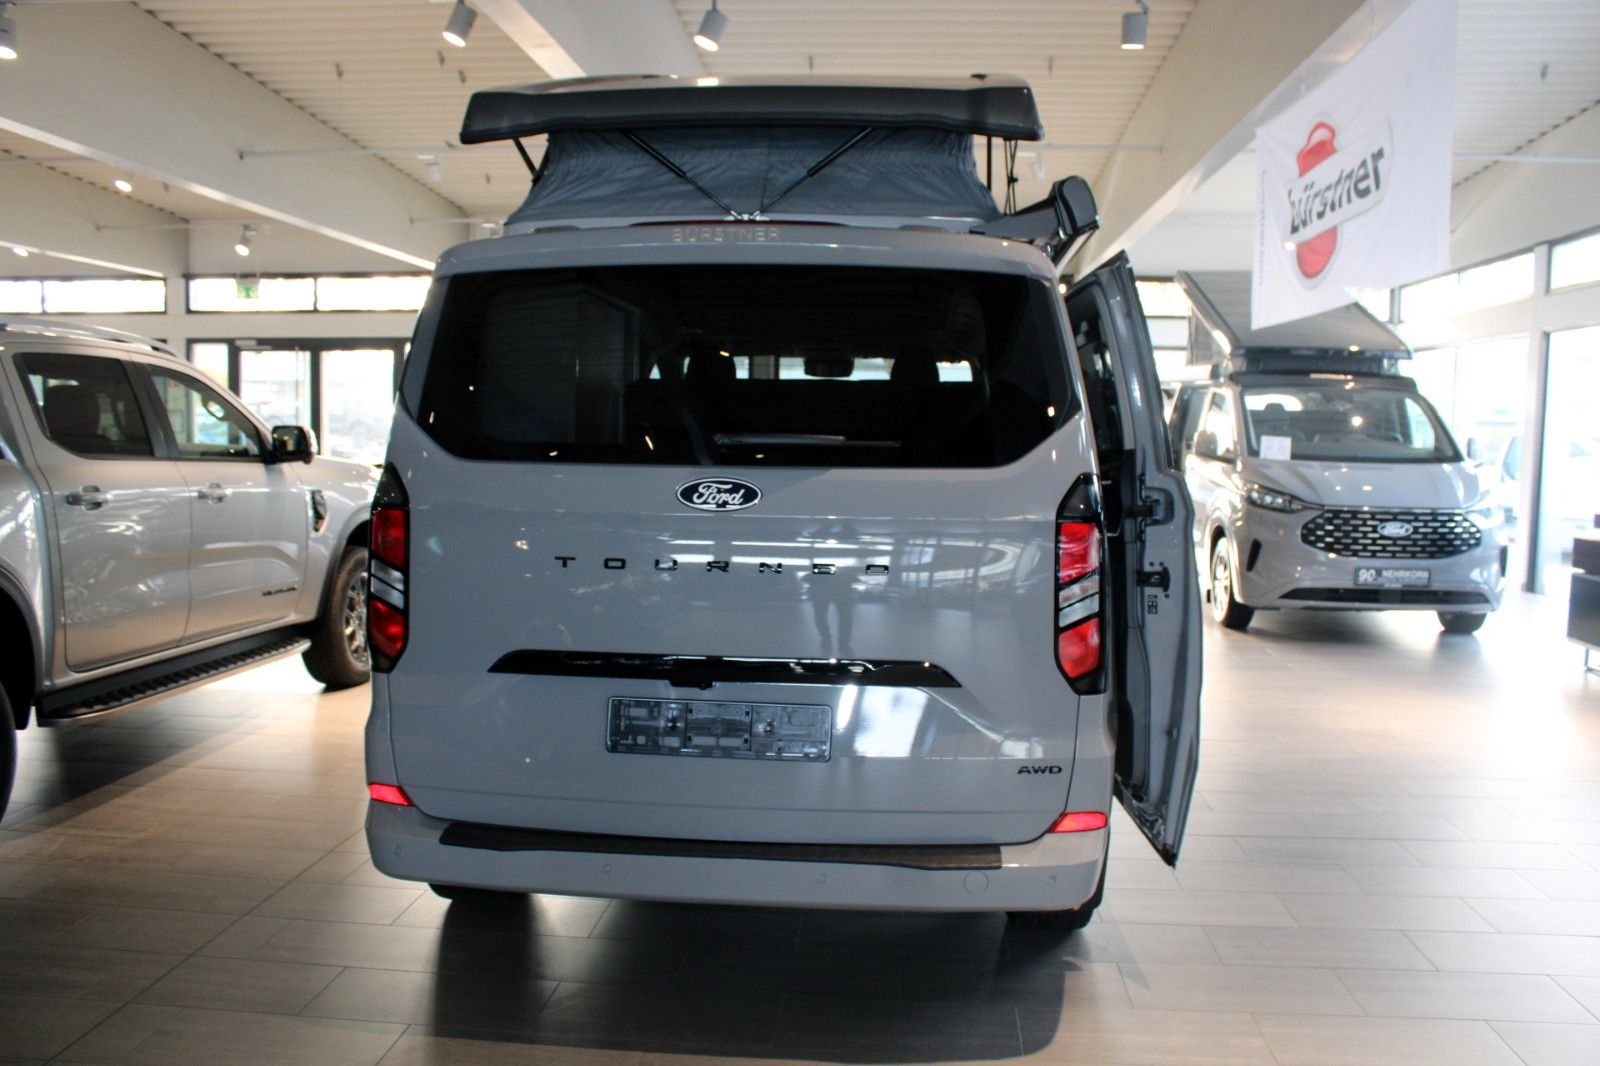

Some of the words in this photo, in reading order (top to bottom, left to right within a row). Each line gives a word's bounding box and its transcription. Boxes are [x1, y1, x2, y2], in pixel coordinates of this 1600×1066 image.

[1288, 146, 1385, 235] bürstner
[692, 482, 746, 504] Ford
[554, 556, 890, 575] TOURNEO
[1017, 765, 1063, 775] AWD
